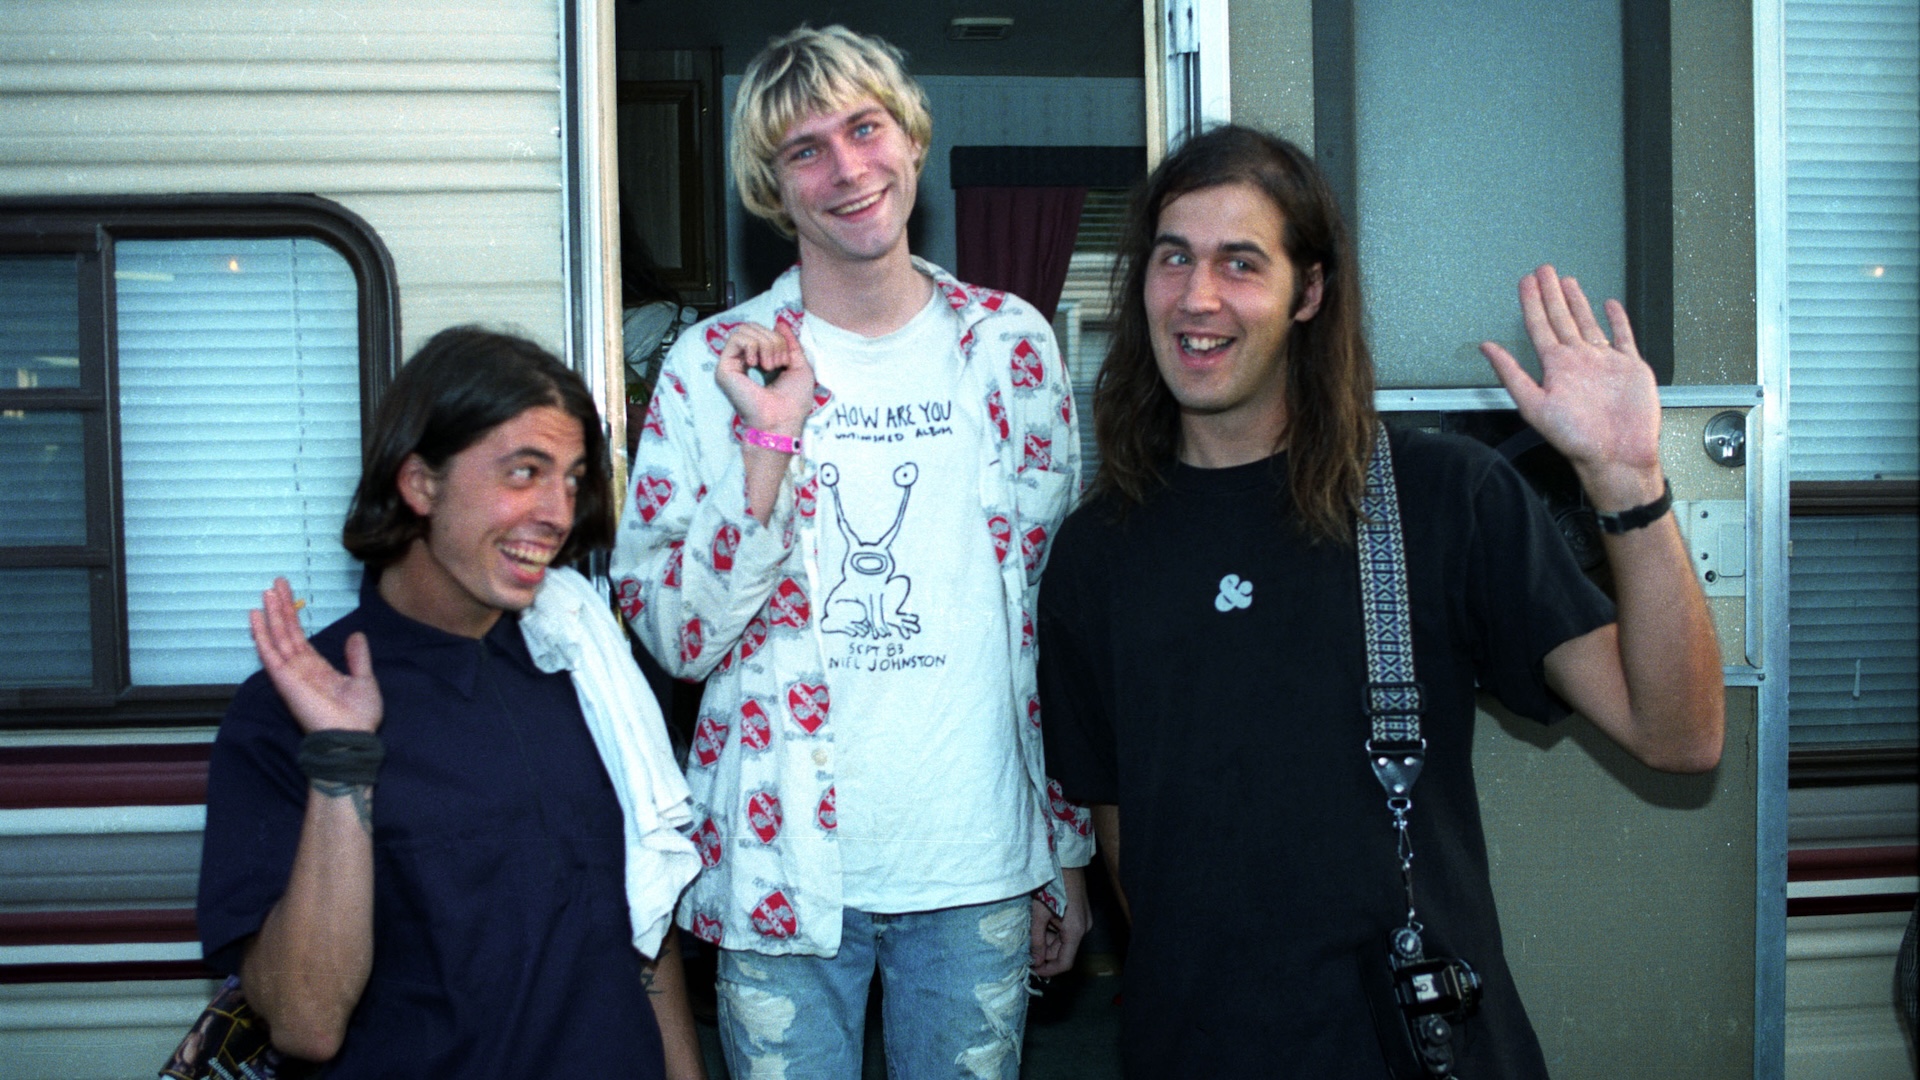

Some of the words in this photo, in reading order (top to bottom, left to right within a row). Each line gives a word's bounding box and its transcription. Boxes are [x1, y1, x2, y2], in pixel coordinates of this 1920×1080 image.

[835, 402, 879, 429] HOW
[886, 404, 915, 428] ARE
[918, 400, 952, 423] YOU
[915, 426, 953, 438] ALBUM
[848, 642, 880, 657] SEPT
[886, 642, 905, 657] 83
[828, 656, 860, 670] NIEL
[867, 654, 947, 672] JOHNSTON
